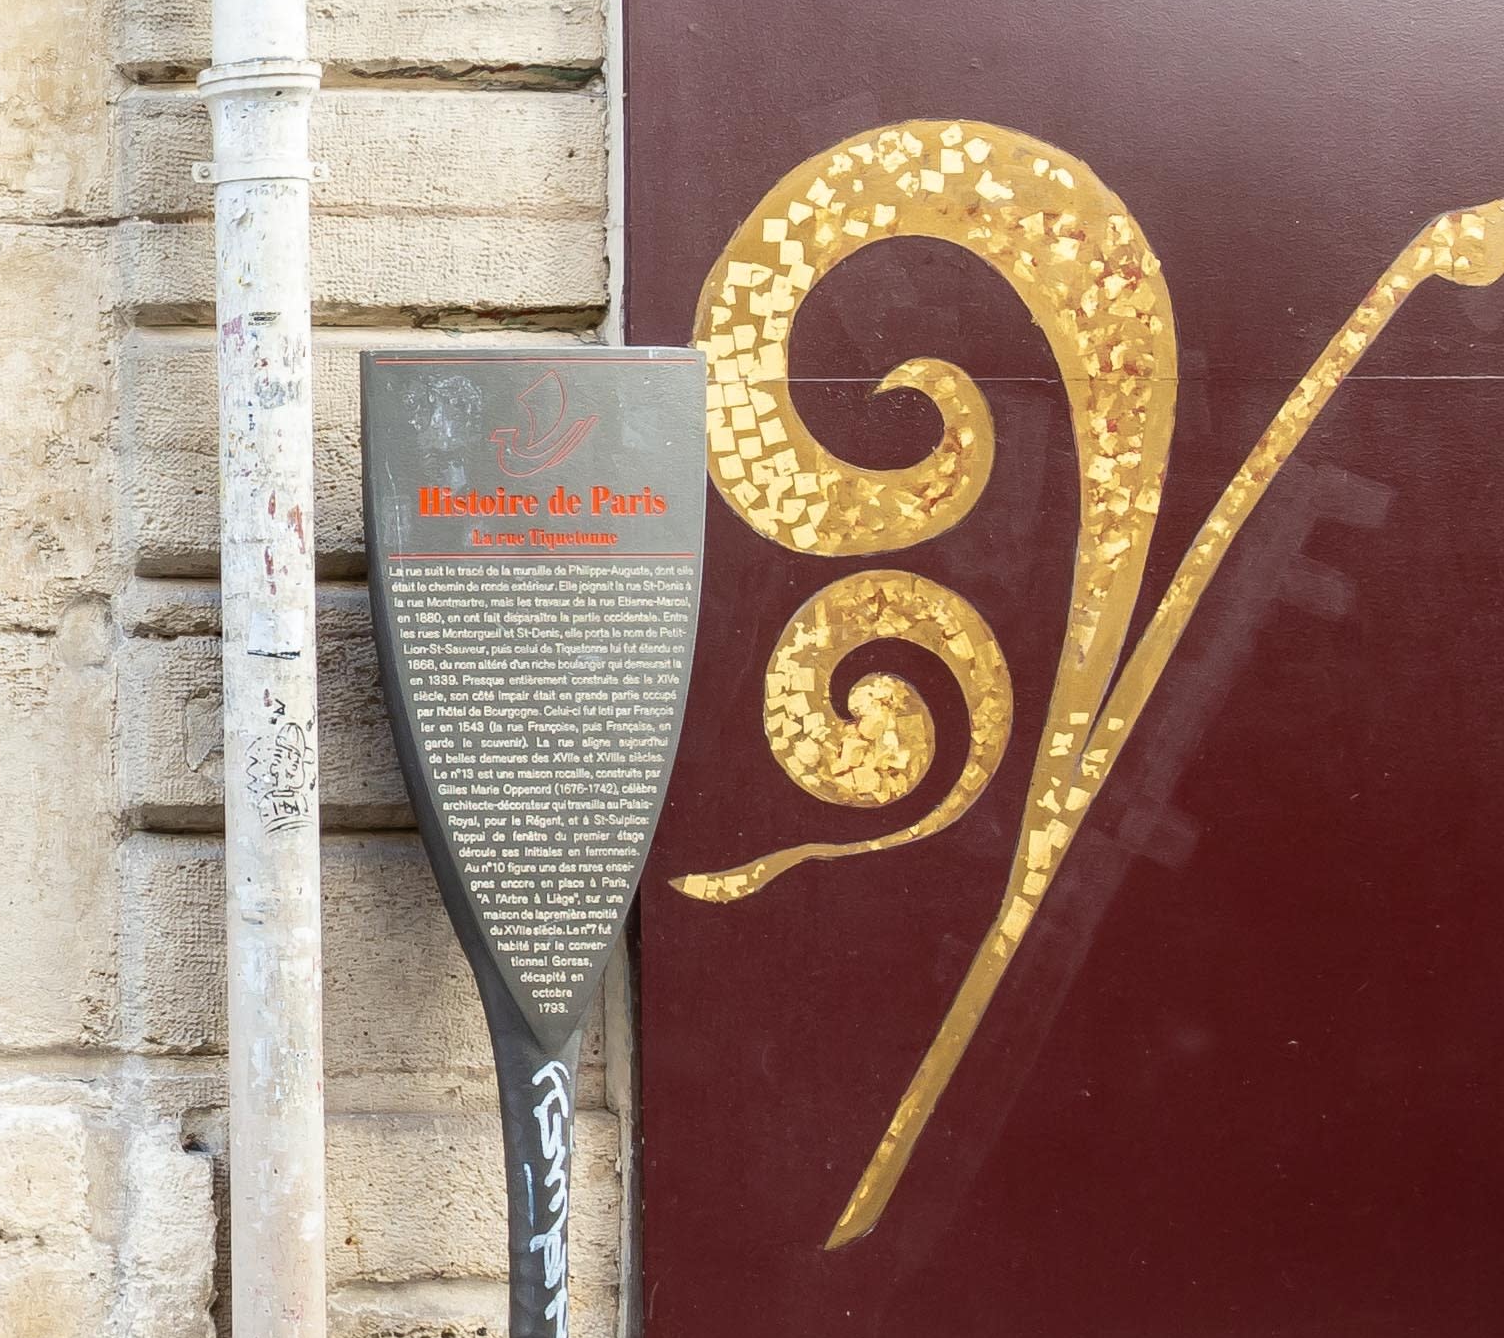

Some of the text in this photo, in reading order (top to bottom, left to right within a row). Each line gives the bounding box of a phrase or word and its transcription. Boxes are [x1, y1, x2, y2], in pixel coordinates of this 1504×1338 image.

[418, 485, 667, 517] Histoire de Paris
[472, 527, 619, 550] La rue Tiquetonne
[389, 566, 404, 576] La
[406, 568, 422, 576] rue
[425, 566, 444, 576] suit
[446, 566, 455, 576] le
[486, 566, 499, 576] de
[502, 566, 510, 576] la
[513, 566, 552, 576] muraille
[554, 566, 566, 576] de
[569, 566, 652, 579] Philippe-Auguste,
[655, 566, 674, 576] dont
[677, 566, 693, 576] elle
[392, 581, 415, 591] était
[417, 581, 427, 591] le
[429, 581, 465, 591] chemin
[466, 581, 479, 591] de
[481, 581, 509, 591] ronde
[559, 581, 577, 591] Elle
[579, 581, 613, 594] joignait
[616, 581, 624, 591] la
[626, 583, 641, 591] rue
[644, 581, 683, 591] St-Denis
[393, 597, 404, 607] la
[407, 599, 424, 607] rue
[427, 597, 488, 609] Montmartre,
[491, 597, 514, 607] mais
[517, 597, 531, 607] les
[535, 597, 570, 607] travaux
[573, 597, 585, 607] de
[588, 597, 596, 607] la
[600, 599, 615, 607] rue
[397, 615, 410, 623] en
[416, 612, 444, 624] 1880,
[448, 615, 460, 623] en
[464, 612, 480, 623] ont
[484, 612, 500, 623] fait
[560, 612, 569, 623] la
[573, 612, 600, 626] partie
[604, 612, 660, 623] occidentale.
[664, 612, 688, 623] Entre
[404, 643, 489, 655] Lion-St-Sauveur,
[491, 643, 512, 657] puis
[514, 643, 538, 654] celui
[540, 643, 552, 654] de
[555, 643, 608, 657] Tiquetonne
[610, 643, 621, 654] lui
[624, 643, 636, 654] fut
[673, 646, 684, 654] en
[410, 677, 423, 685] en
[429, 675, 458, 685] 1339.
[463, 675, 504, 688] Presque
[623, 675, 639, 685] dès
[644, 675, 652, 685] le
[658, 675, 679, 685] XIVe
[424, 737, 454, 751] garde
[463, 737, 472, 748] le
[537, 737, 550, 748] La
[558, 740, 574, 748] rue
[582, 737, 610, 751] aligne
[438, 784, 467, 795] Gilles
[471, 784, 499, 795] Marie
[503, 784, 551, 797] Oppenord
[492, 831, 505, 842] de
[513, 831, 547, 842] fenêtre
[555, 831, 566, 842] du
[574, 831, 609, 845] premier
[459, 847, 640, 857] déroule ses initiales en ferronnerie.
[464, 863, 479, 873] Au
[508, 863, 536, 876] figure
[539, 865, 556, 873] une
[559, 863, 576, 873] des
[579, 865, 603, 873] rares
[534, 943, 551, 955] par
[555, 941, 564, 951] le
[511, 957, 592, 969] tionnel Gorsas,
[571, 974, 583, 982] en
[532, 989, 572, 999] octobre
[539, 1003, 568, 1014] 1793.
